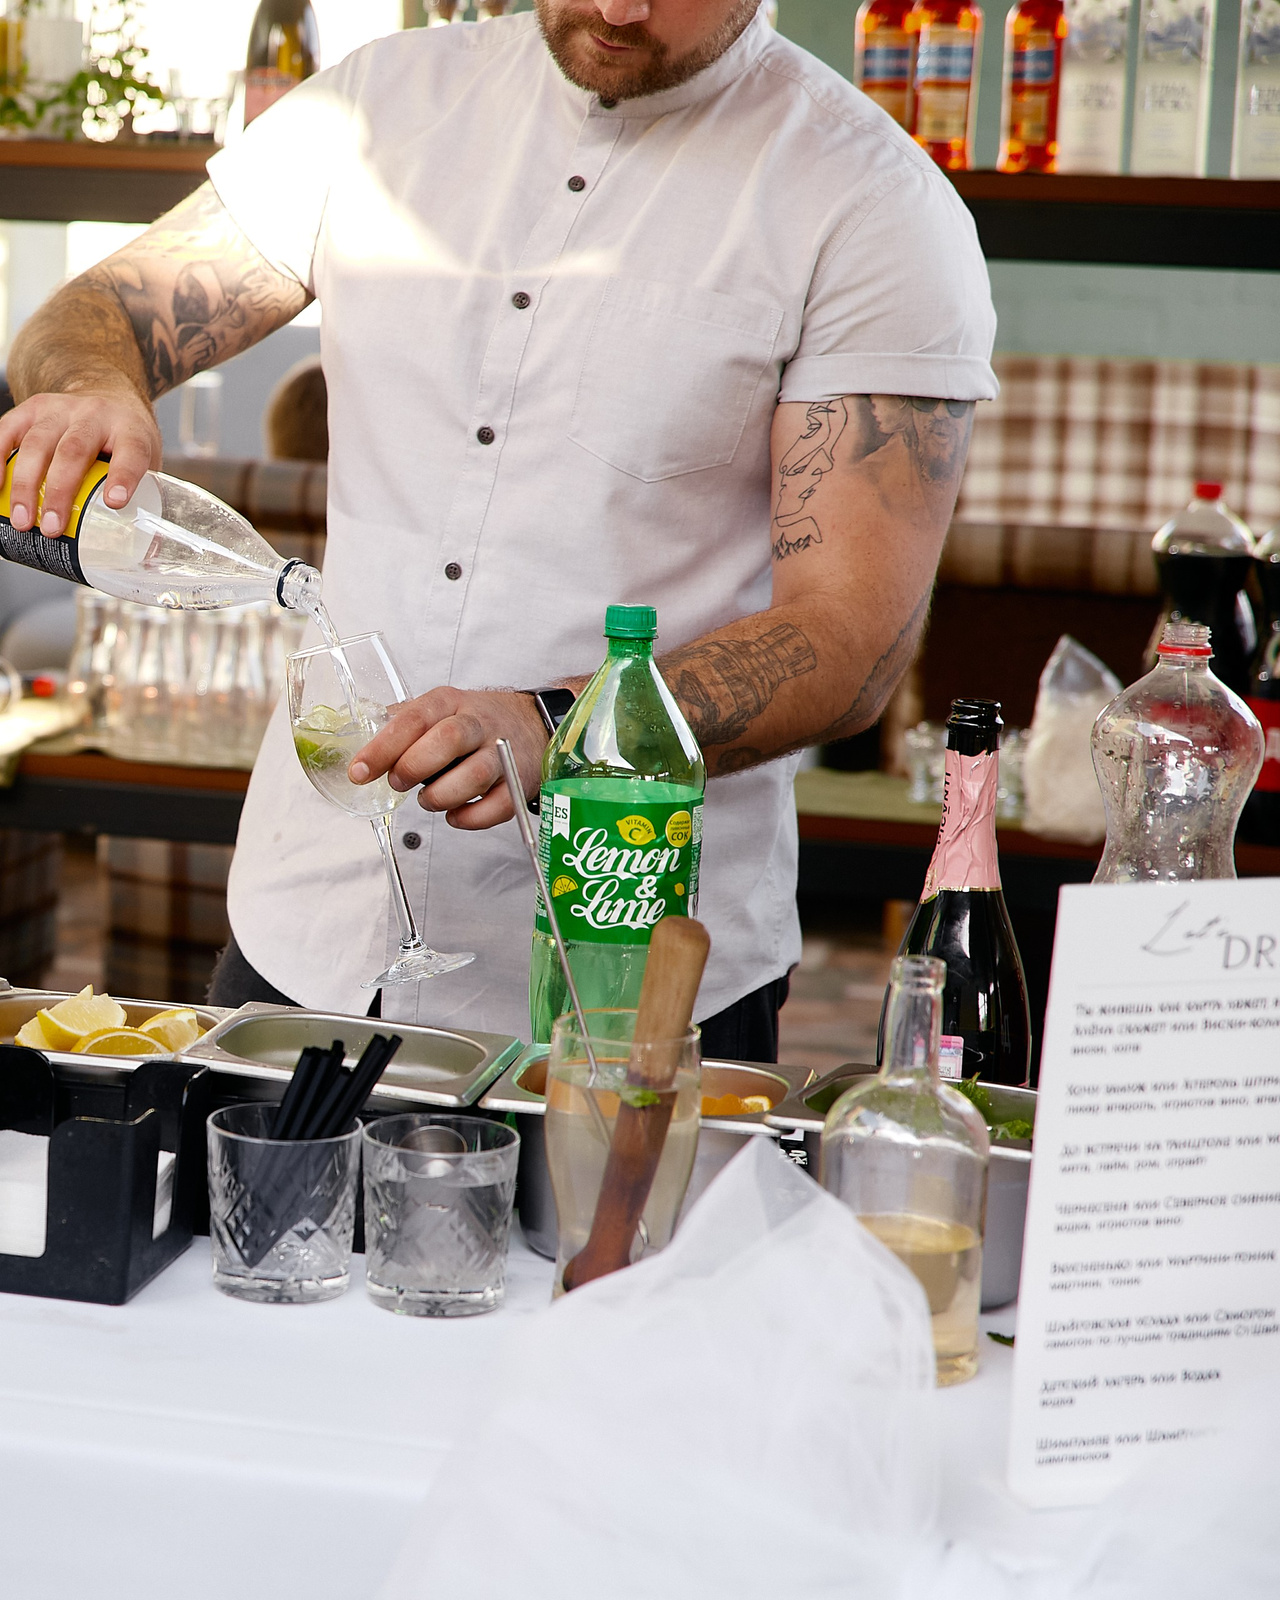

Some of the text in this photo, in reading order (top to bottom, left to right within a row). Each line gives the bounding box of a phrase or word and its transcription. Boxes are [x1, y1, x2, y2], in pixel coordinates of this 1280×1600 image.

[625, 818, 652, 835] VITAMIN
[629, 828, 641, 841] C
[562, 827, 681, 880] Lemon
[634, 875, 657, 899] &
[570, 879, 666, 930] Lime
